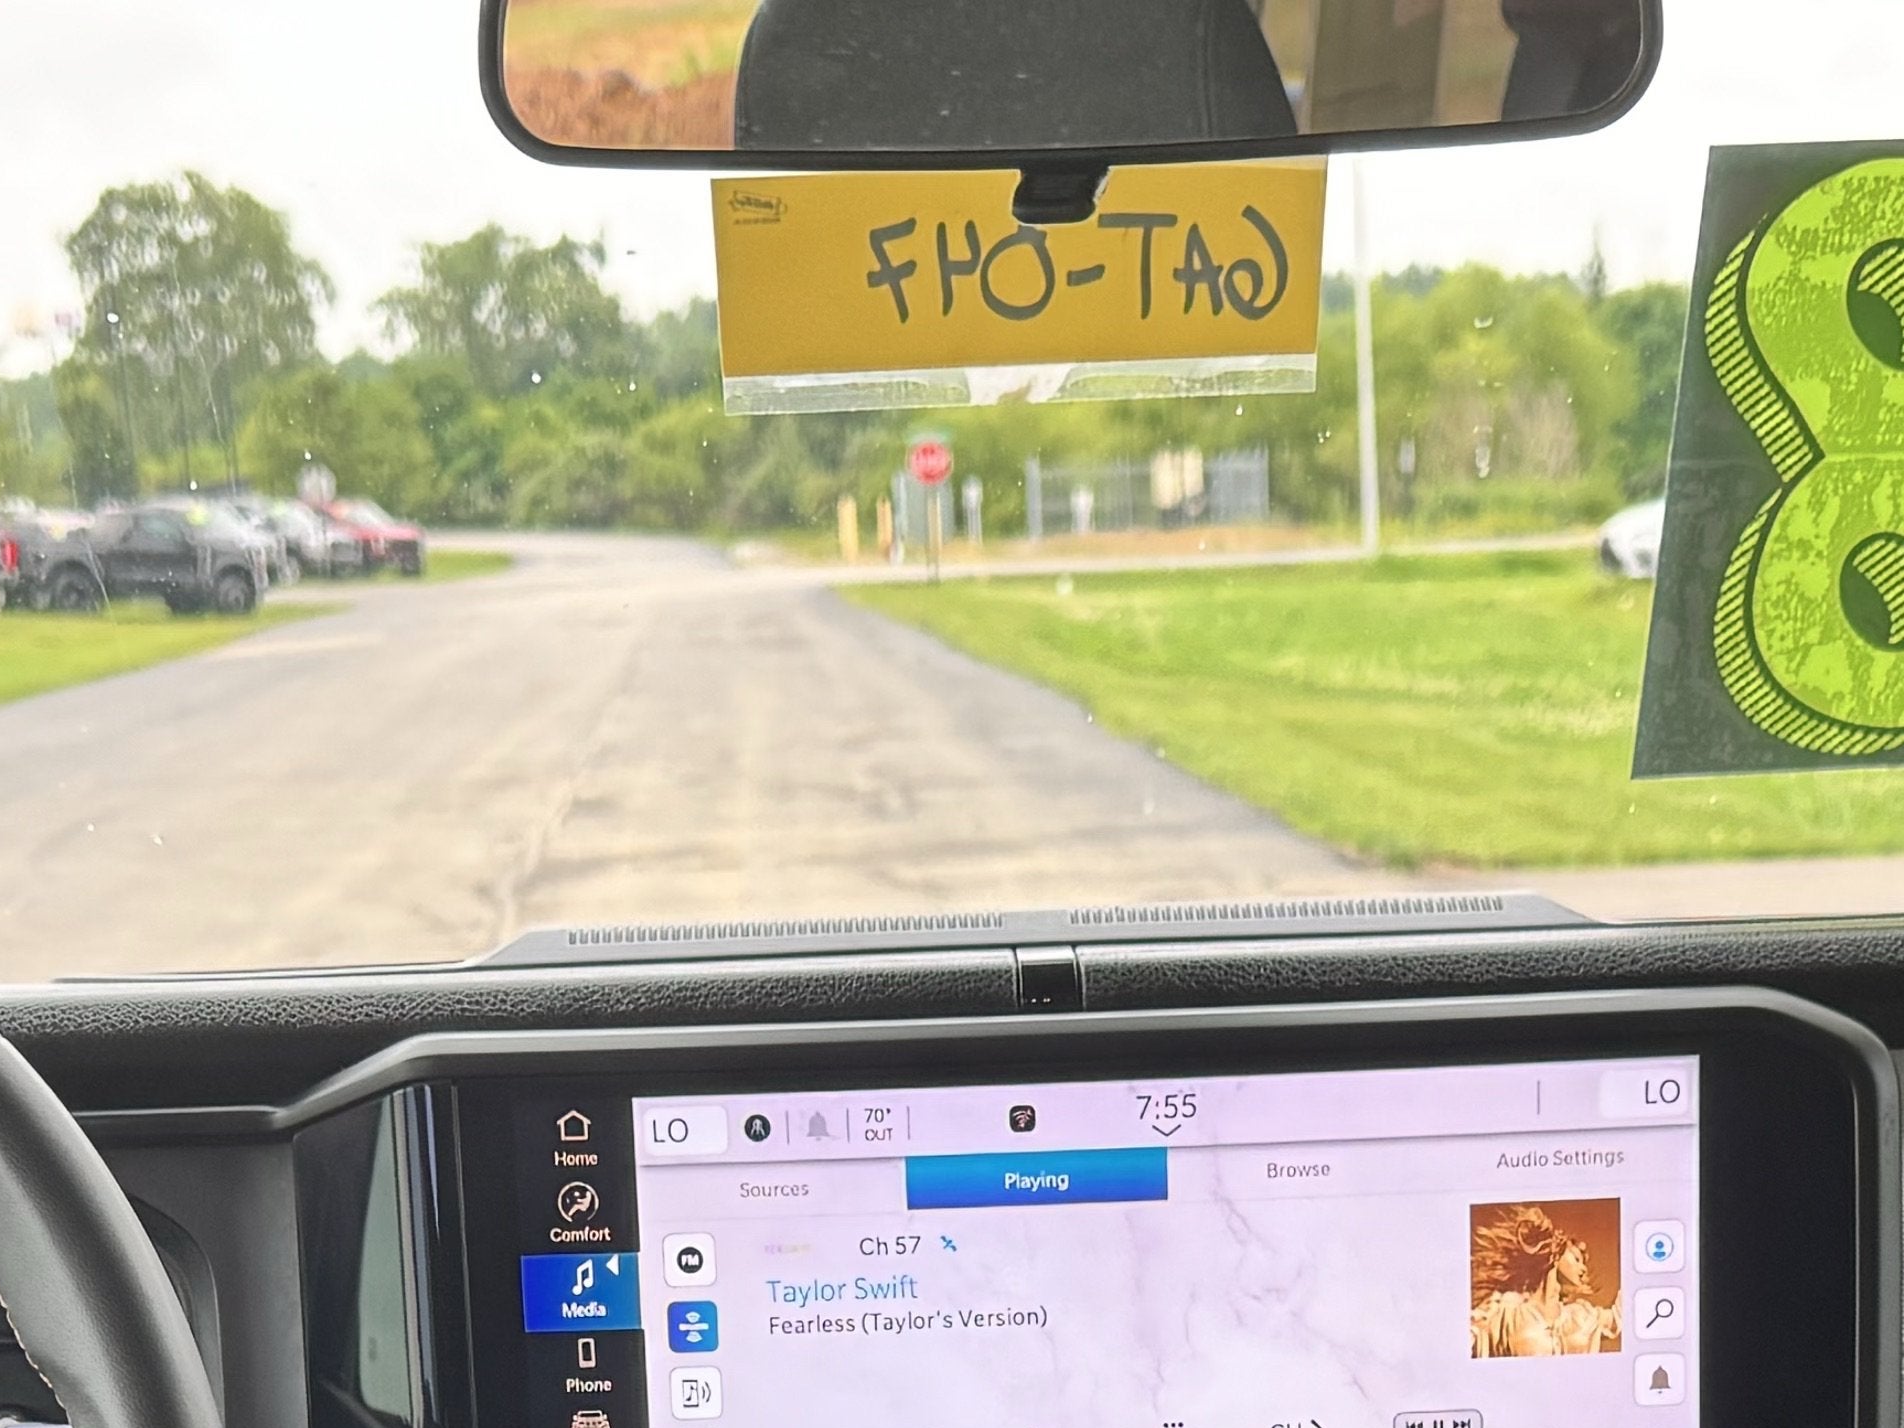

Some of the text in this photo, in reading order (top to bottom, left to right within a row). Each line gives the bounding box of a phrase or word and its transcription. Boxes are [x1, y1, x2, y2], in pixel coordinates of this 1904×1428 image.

[1644, 1080, 1681, 1105] LO
[1136, 1093, 1197, 1121] 7:55
[652, 1117, 689, 1144] LO
[864, 1128, 893, 1142] OUT
[554, 1152, 598, 1166] Home
[1496, 1147, 1625, 1171] Audio Settings
[1267, 1160, 1331, 1179] Browse
[740, 1182, 810, 1199] Sources
[1004, 1170, 1069, 1192] Playing
[550, 1227, 611, 1243] Comfort
[859, 1236, 921, 1256] Ch 57
[767, 1275, 919, 1307] Taylor Swift
[562, 1303, 607, 1318] Media
[769, 1305, 1048, 1336] Fearless (Taylor's Version)
[566, 1378, 612, 1394] Phone
